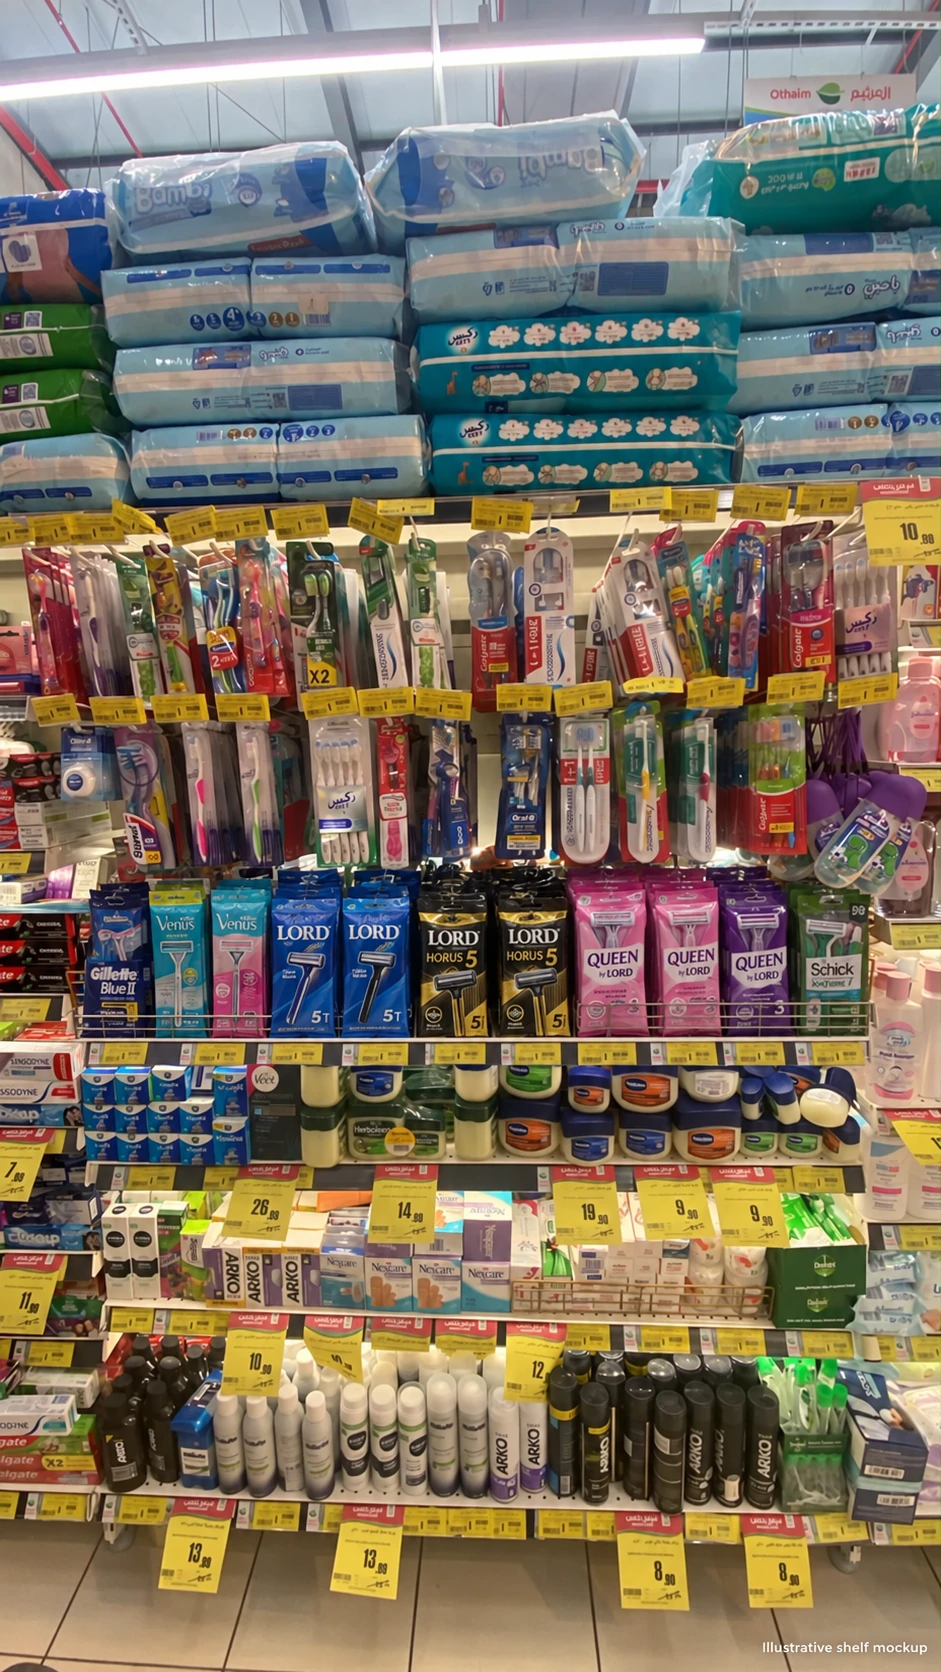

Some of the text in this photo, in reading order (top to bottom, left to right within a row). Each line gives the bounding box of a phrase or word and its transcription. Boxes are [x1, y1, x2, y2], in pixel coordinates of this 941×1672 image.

[770, 88, 811, 99] Othaim
[310, 669, 330, 684] X2
[156, 915, 195, 931] Venus
[216, 913, 257, 931] Venus
[277, 925, 330, 941] LORD
[348, 924, 400, 940] LORD
[427, 930, 480, 946] LORD
[508, 928, 560, 944] LORD
[426, 950, 478, 968] HORUS 5
[506, 948, 558, 966] HORUS 5
[587, 948, 639, 968] QUEEN
[667, 947, 715, 967] QUEEN
[735, 952, 783, 972] QUEEN
[90, 966, 138, 982] Gillette
[607, 968, 633, 978] LORD
[685, 966, 710, 977] LORD
[754, 970, 779, 981] LORD
[811, 962, 855, 977] Schick
[100, 982, 127, 995] Blue
[226, 1251, 241, 1294] ARKO
[246, 1260, 261, 1303] ARKO
[286, 1259, 300, 1303] ARKO
[528, 1428, 540, 1465] ARKO
[689, 1434, 702, 1474] ARKO
[46, 1459, 64, 1467] X2
[496, 1437, 508, 1475] ARKO
[757, 1439, 772, 1478] ARKO
